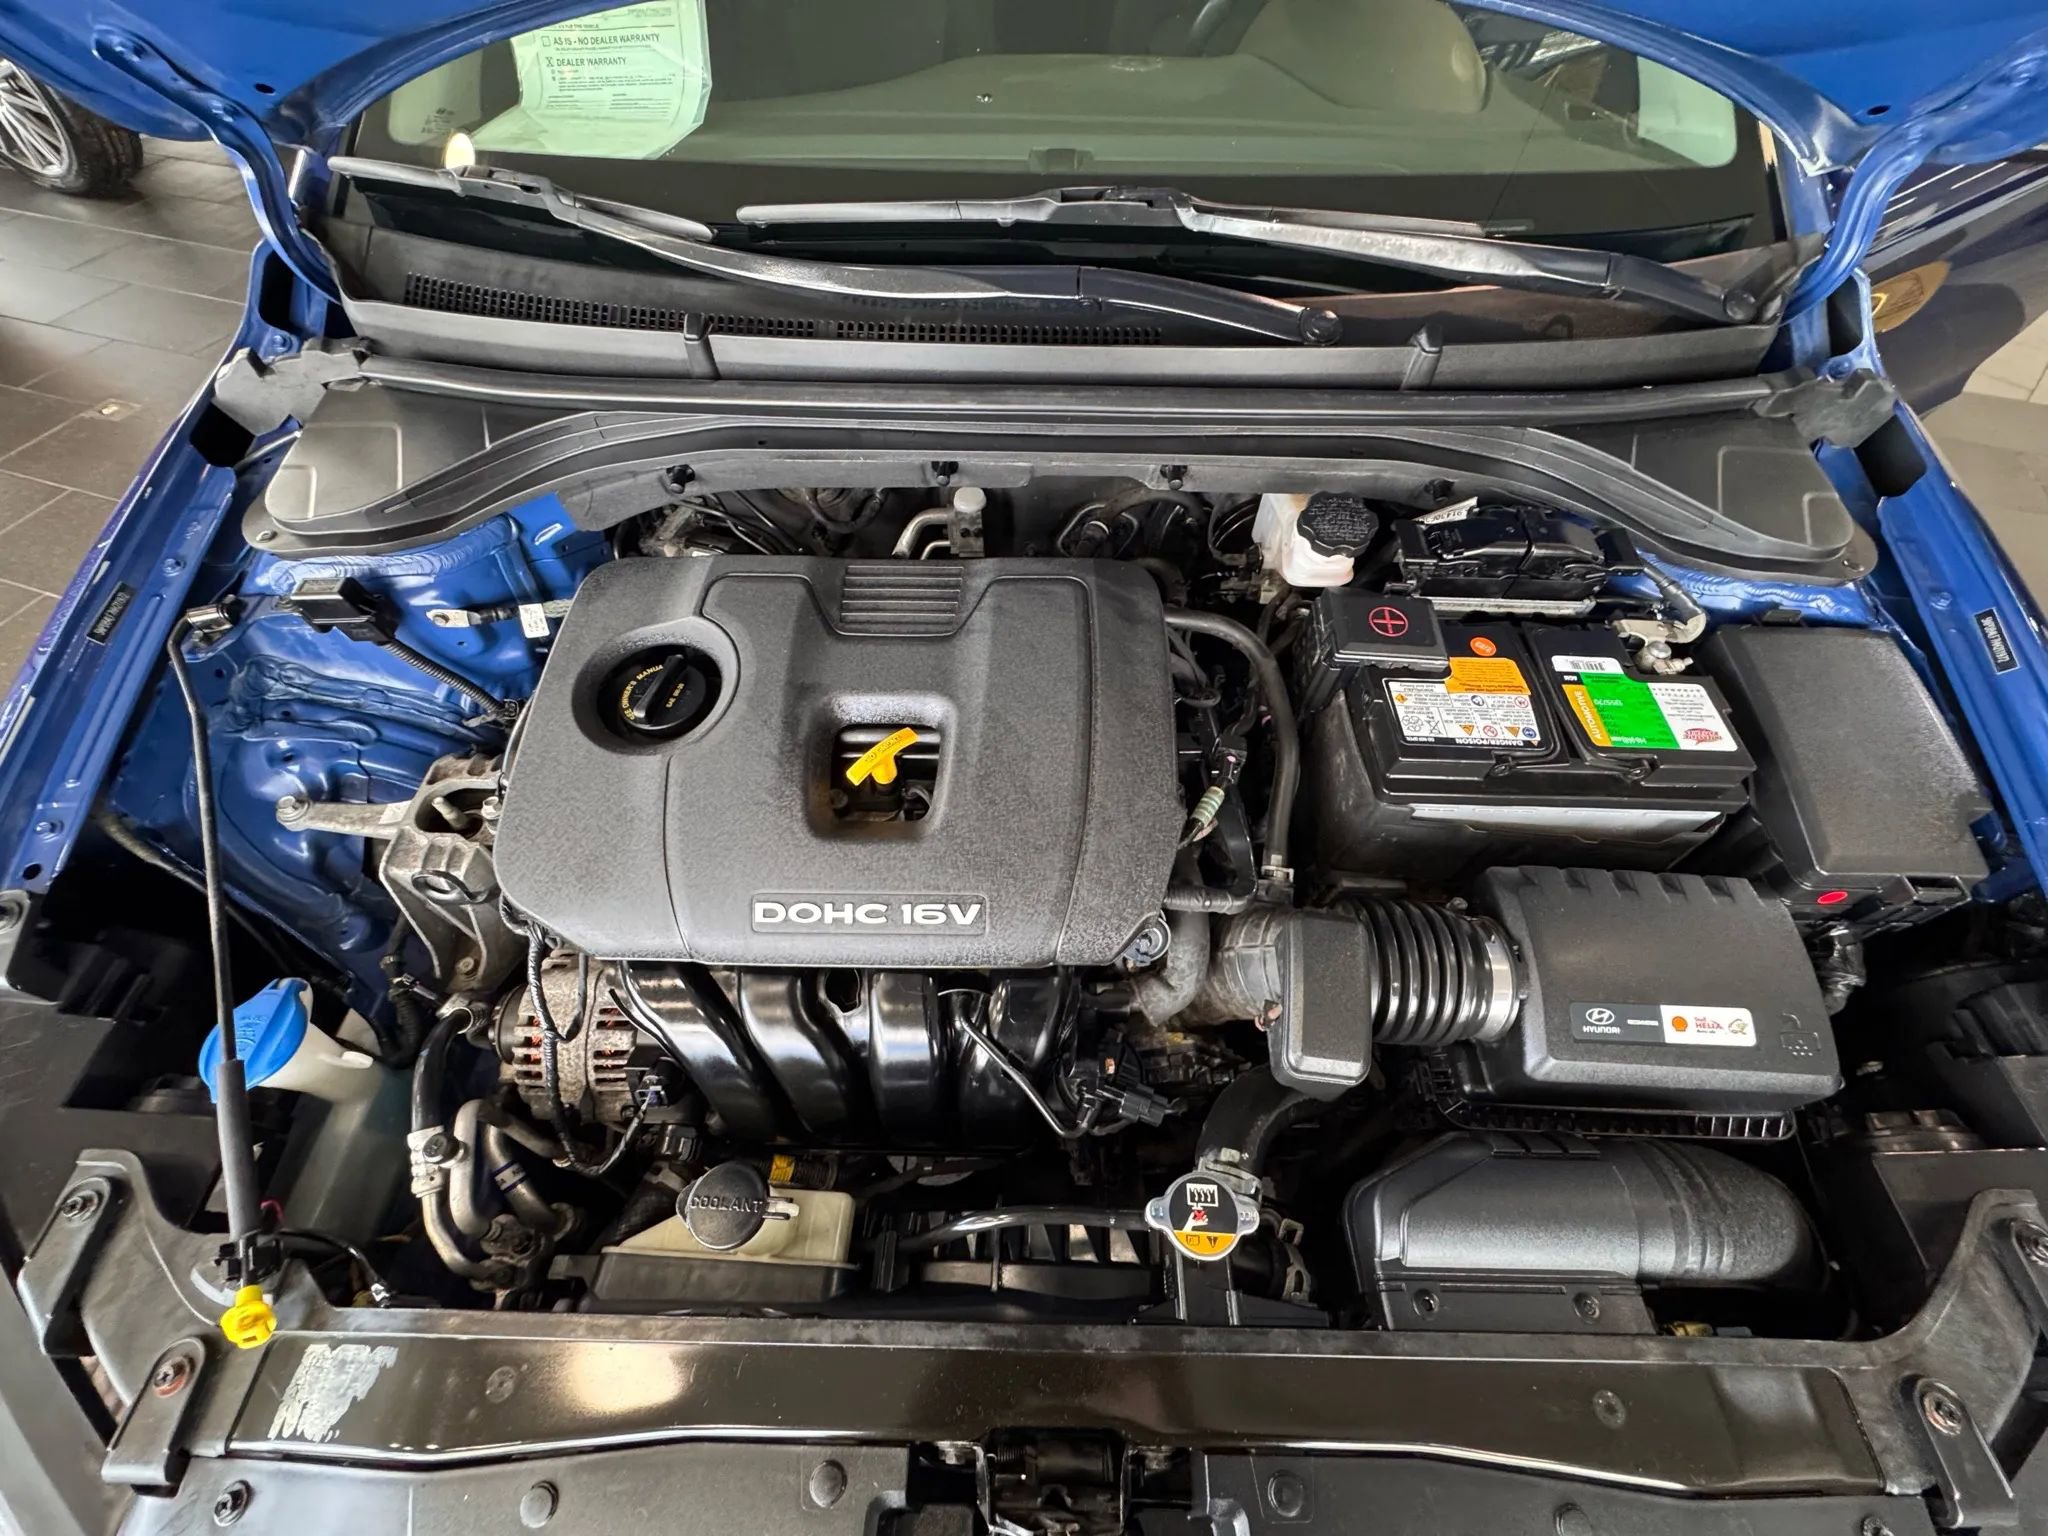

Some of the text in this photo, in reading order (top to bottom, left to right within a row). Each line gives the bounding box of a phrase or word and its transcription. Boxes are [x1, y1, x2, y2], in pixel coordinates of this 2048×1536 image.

[553, 36, 563, 46] AS
[564, 37, 573, 46] IS
[577, 36, 589, 45] NO
[590, 35, 618, 45] DEALER
[619, 33, 660, 43] WARRANTY
[556, 56, 627, 67] DEALER WARRANTY
[636, 664, 664, 680] MANUA
[1574, 689, 1603, 740] AUTOMOTIVE
[1455, 737, 1525, 746] DANGER/POISON
[754, 902, 981, 926] DOHC 16V
[1583, 1025, 1621, 1035] HYUNDAI
[689, 1196, 763, 1213] COOLANT
